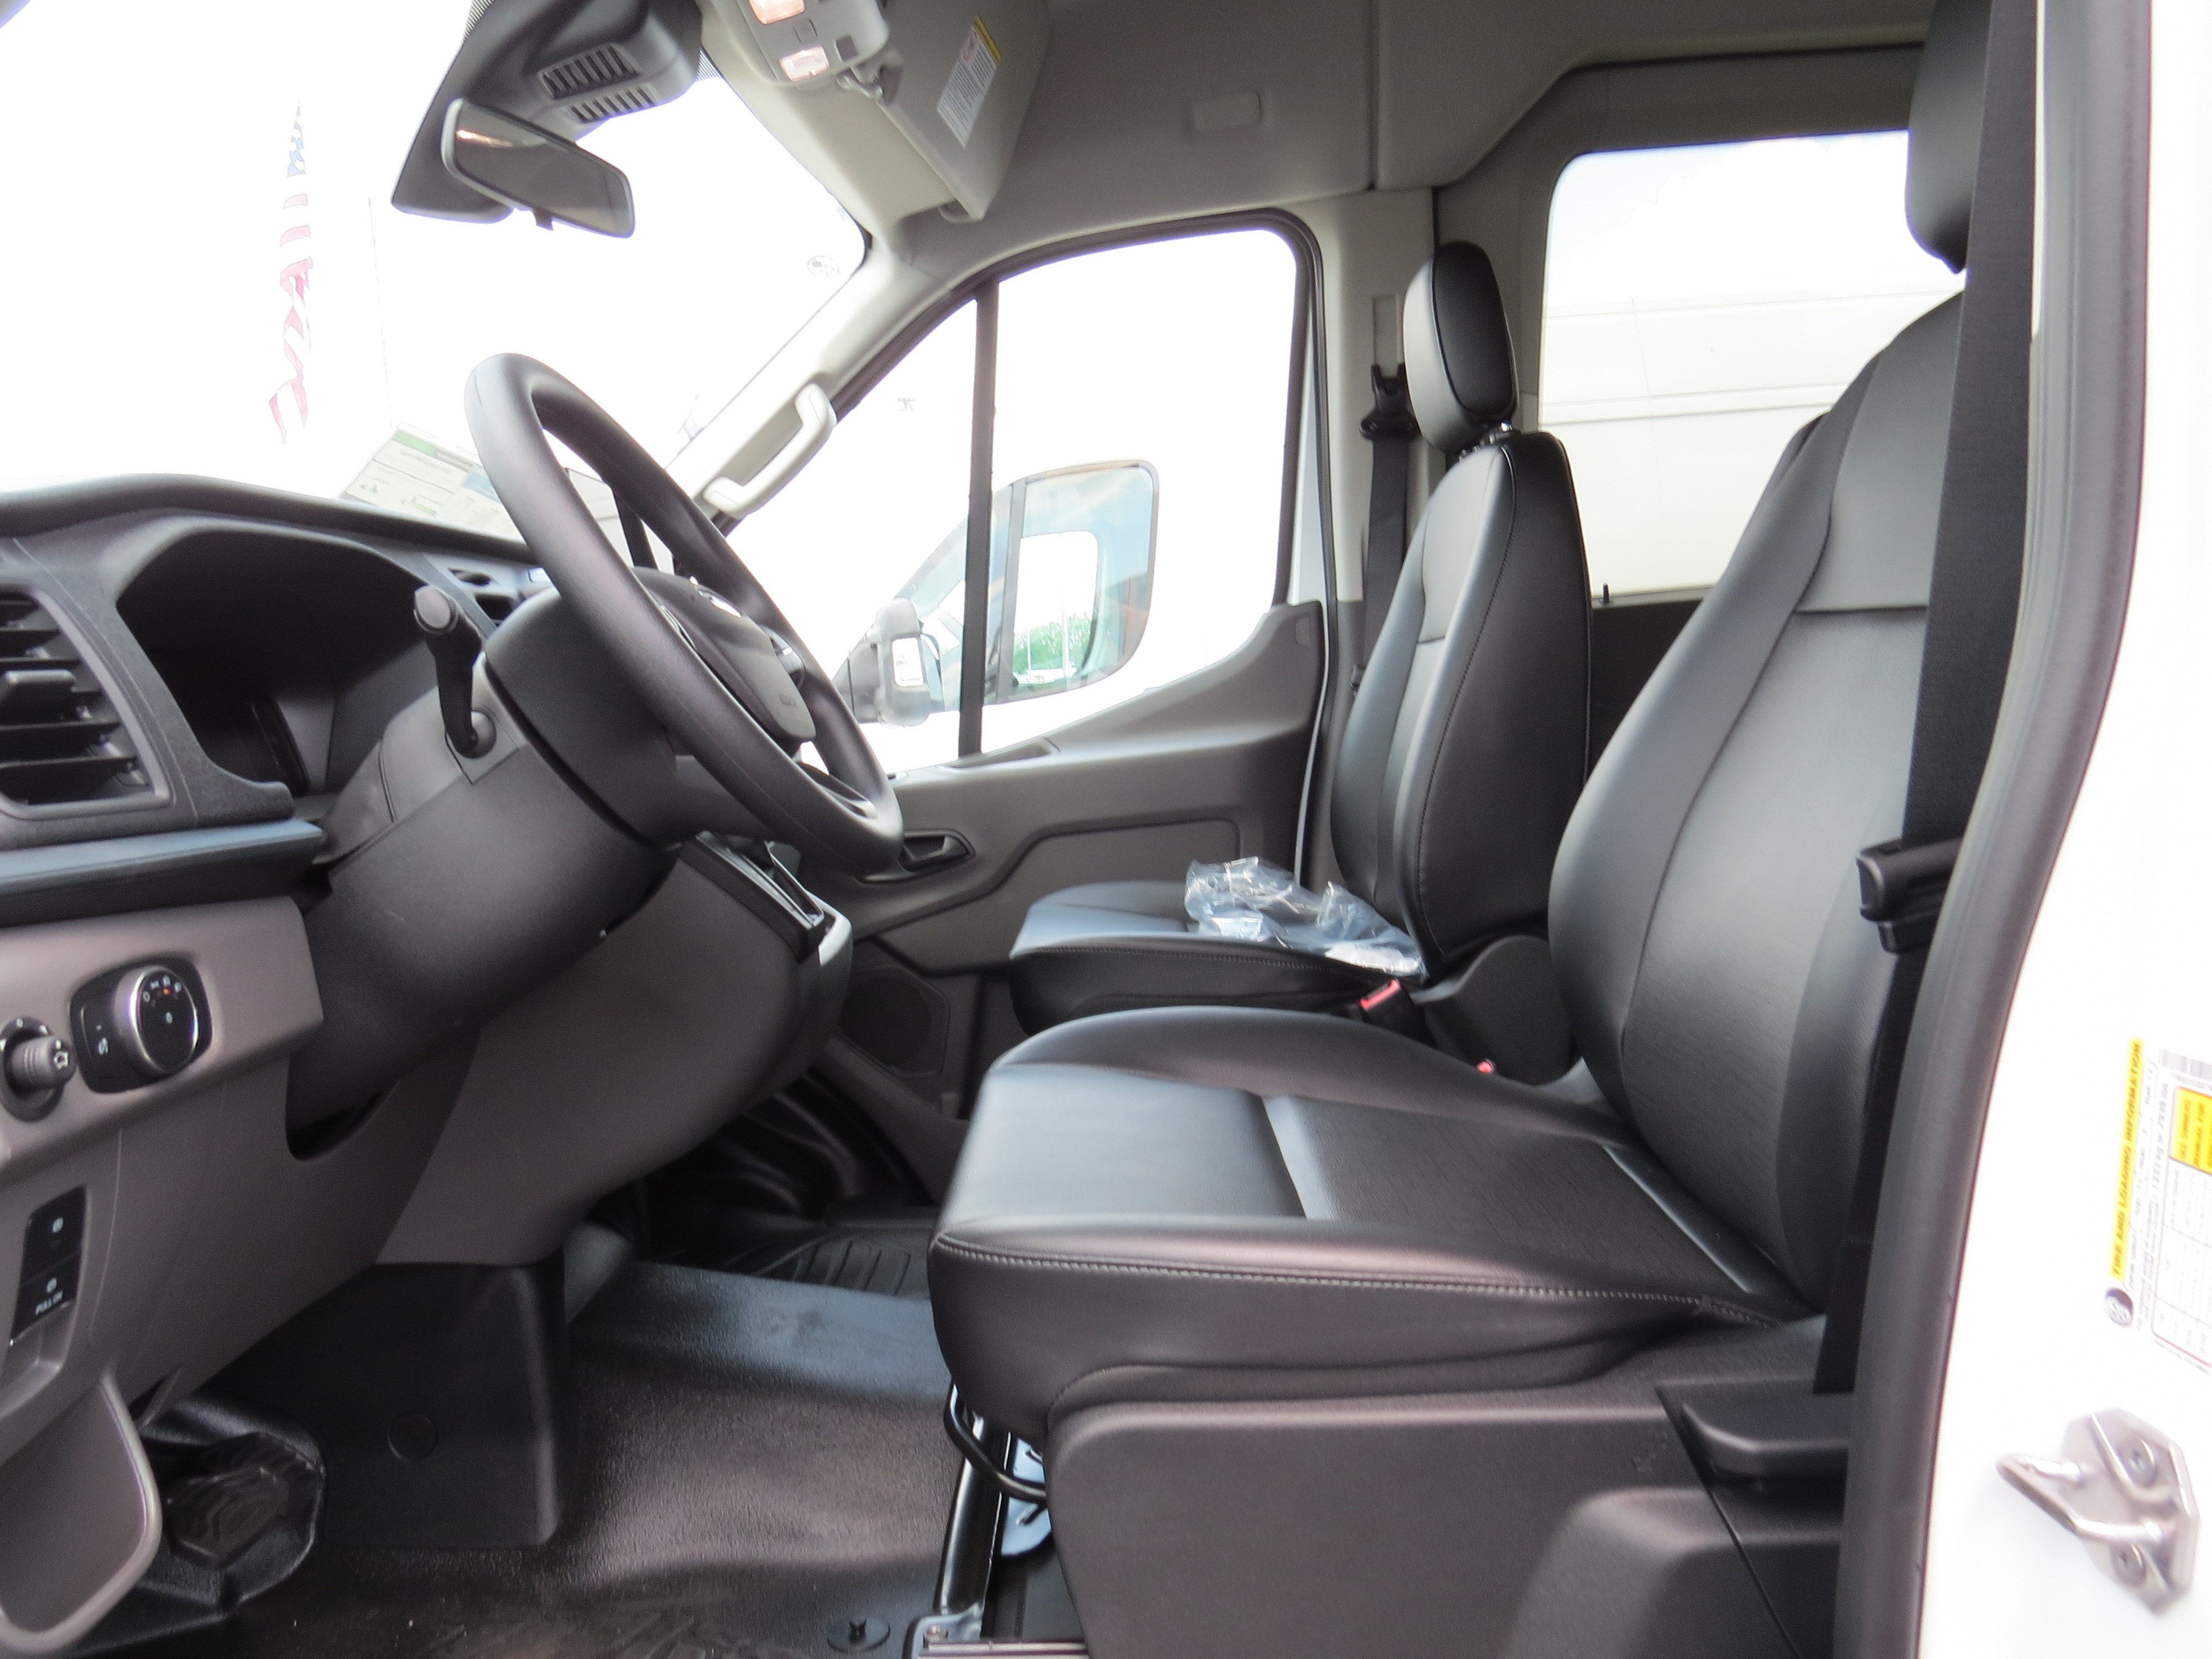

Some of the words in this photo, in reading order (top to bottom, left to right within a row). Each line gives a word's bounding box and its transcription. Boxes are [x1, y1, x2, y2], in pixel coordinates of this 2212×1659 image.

[2125, 1044, 2140, 1141] INFORMATION
[2119, 1145, 2131, 1208] LOADING
[2116, 1211, 2125, 1242] AND
